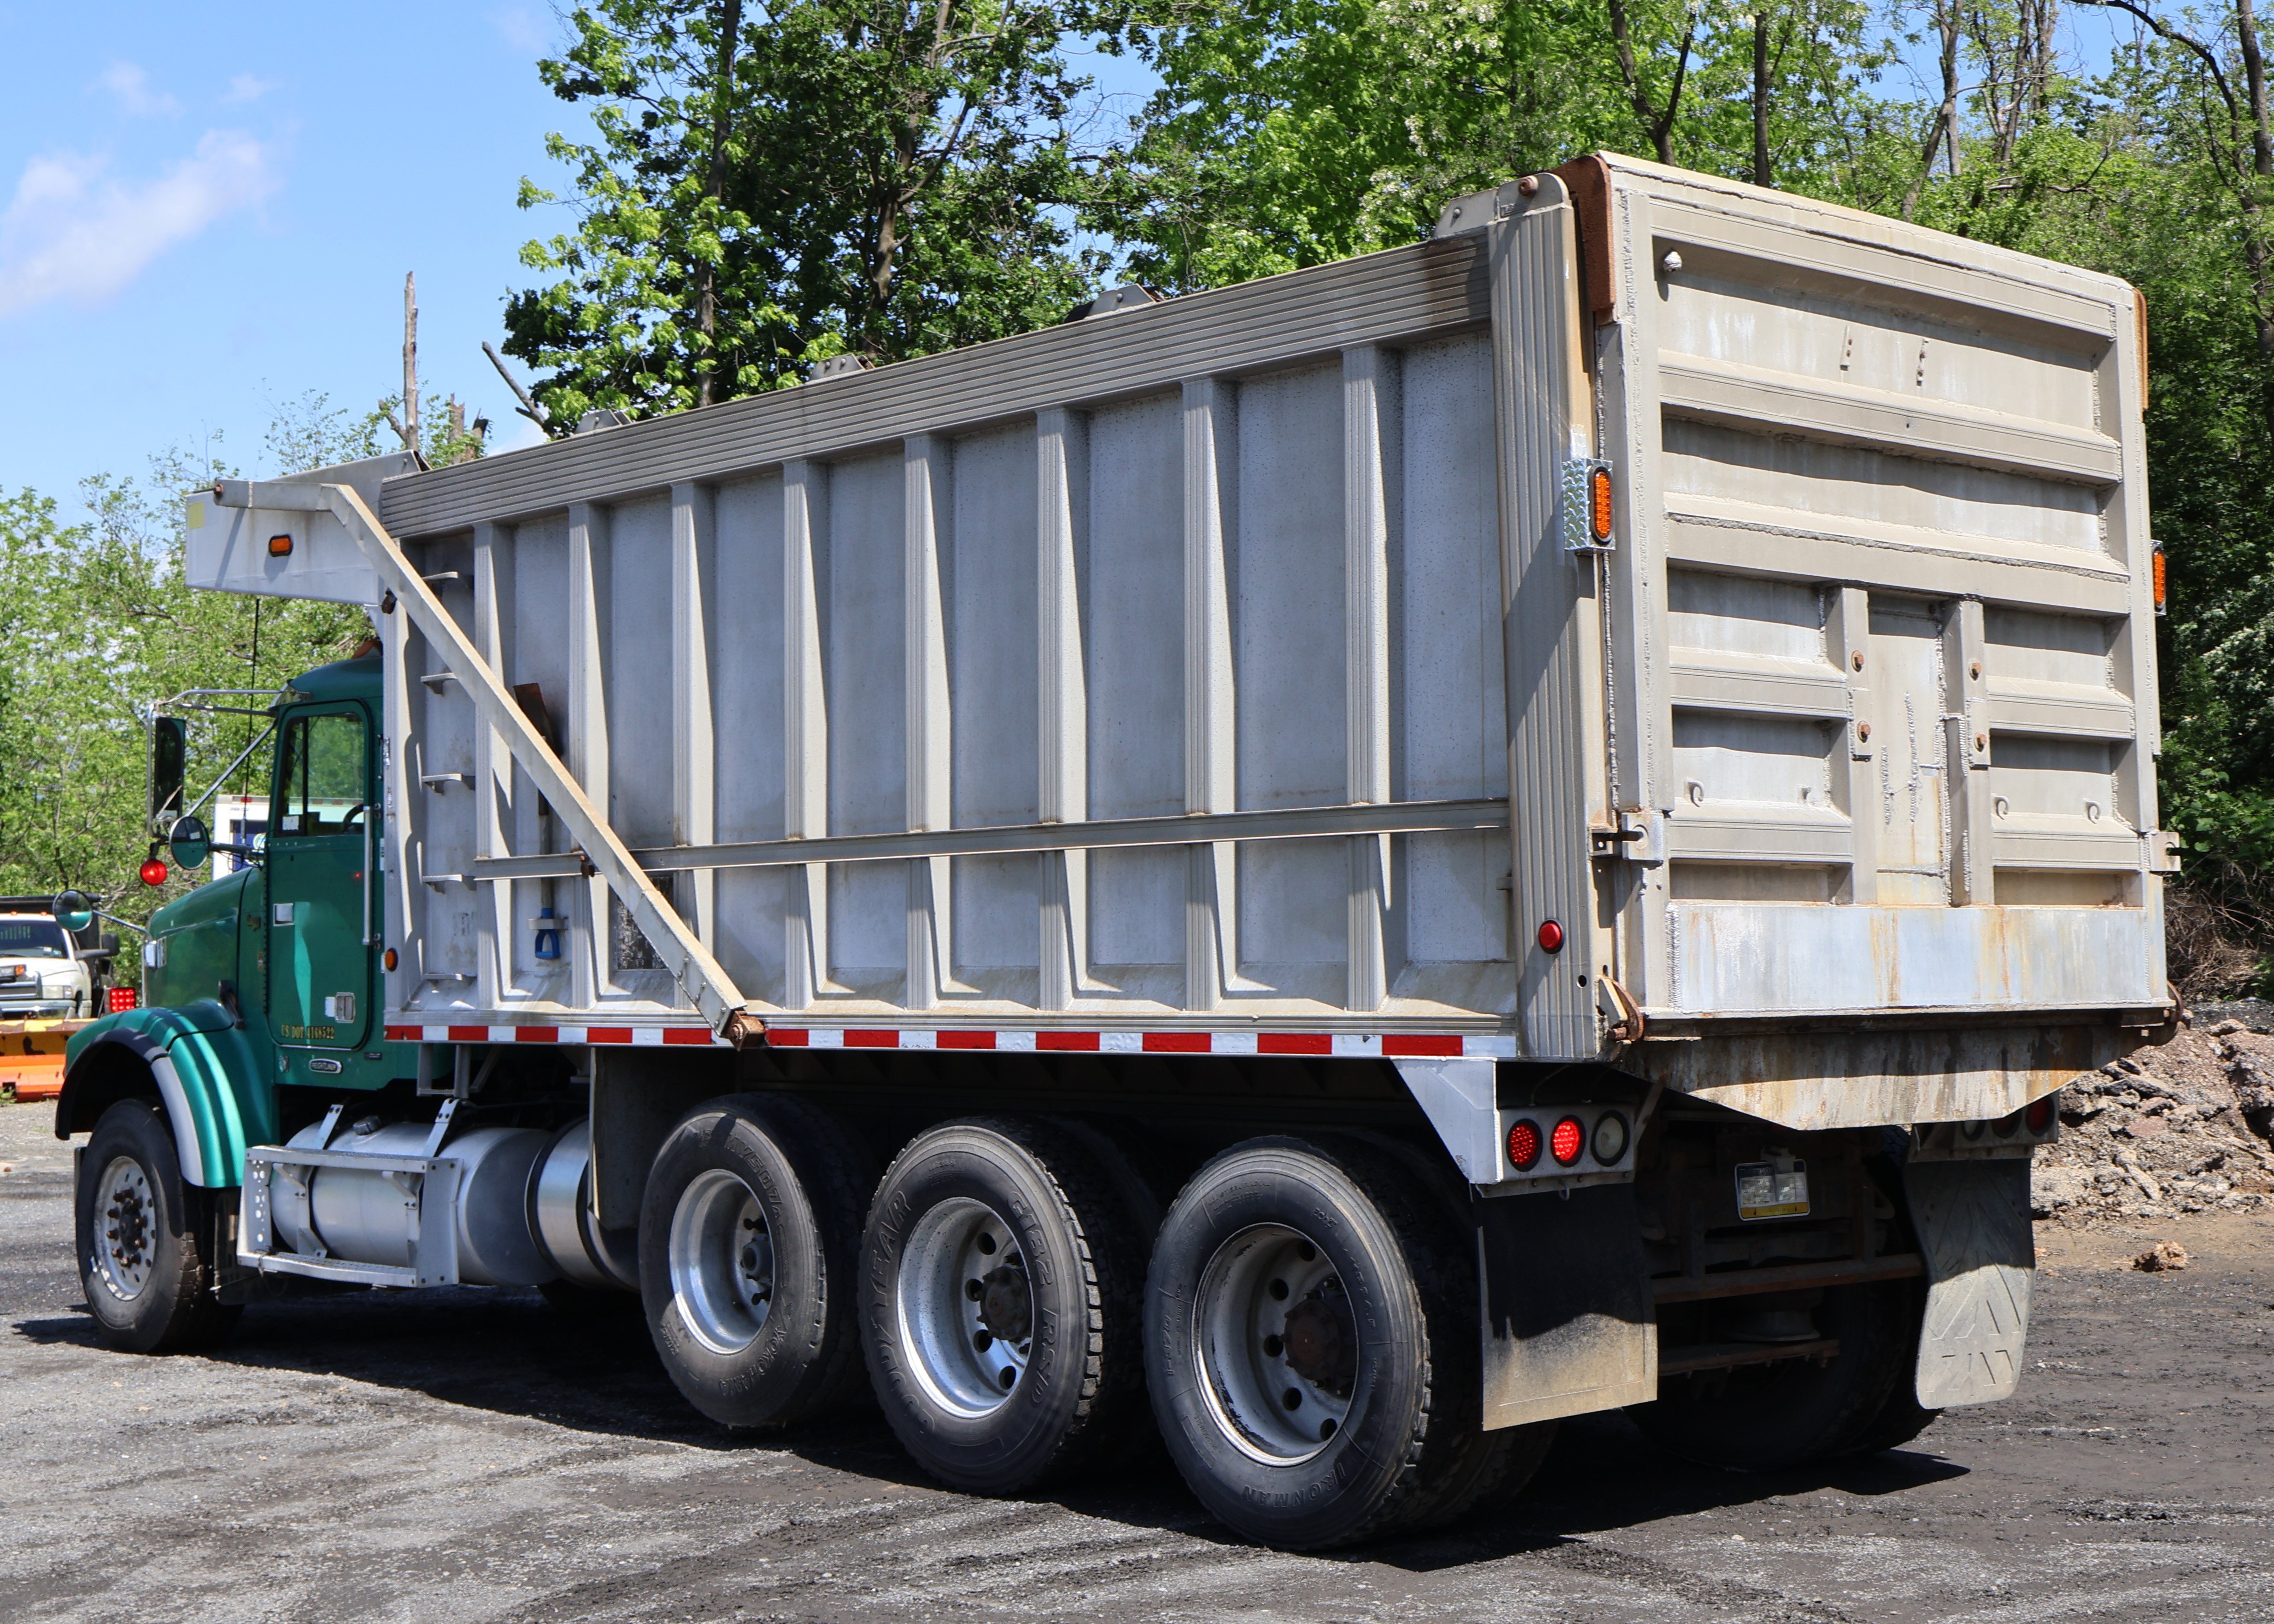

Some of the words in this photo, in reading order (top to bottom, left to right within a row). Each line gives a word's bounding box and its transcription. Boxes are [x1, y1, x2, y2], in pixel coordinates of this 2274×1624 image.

[292, 1026, 304, 1038] DOT
[1011, 1190, 1054, 1286] G182
[719, 1327, 787, 1396] YOKOHAMA
[1242, 1460, 1348, 1509] IRONMAN
